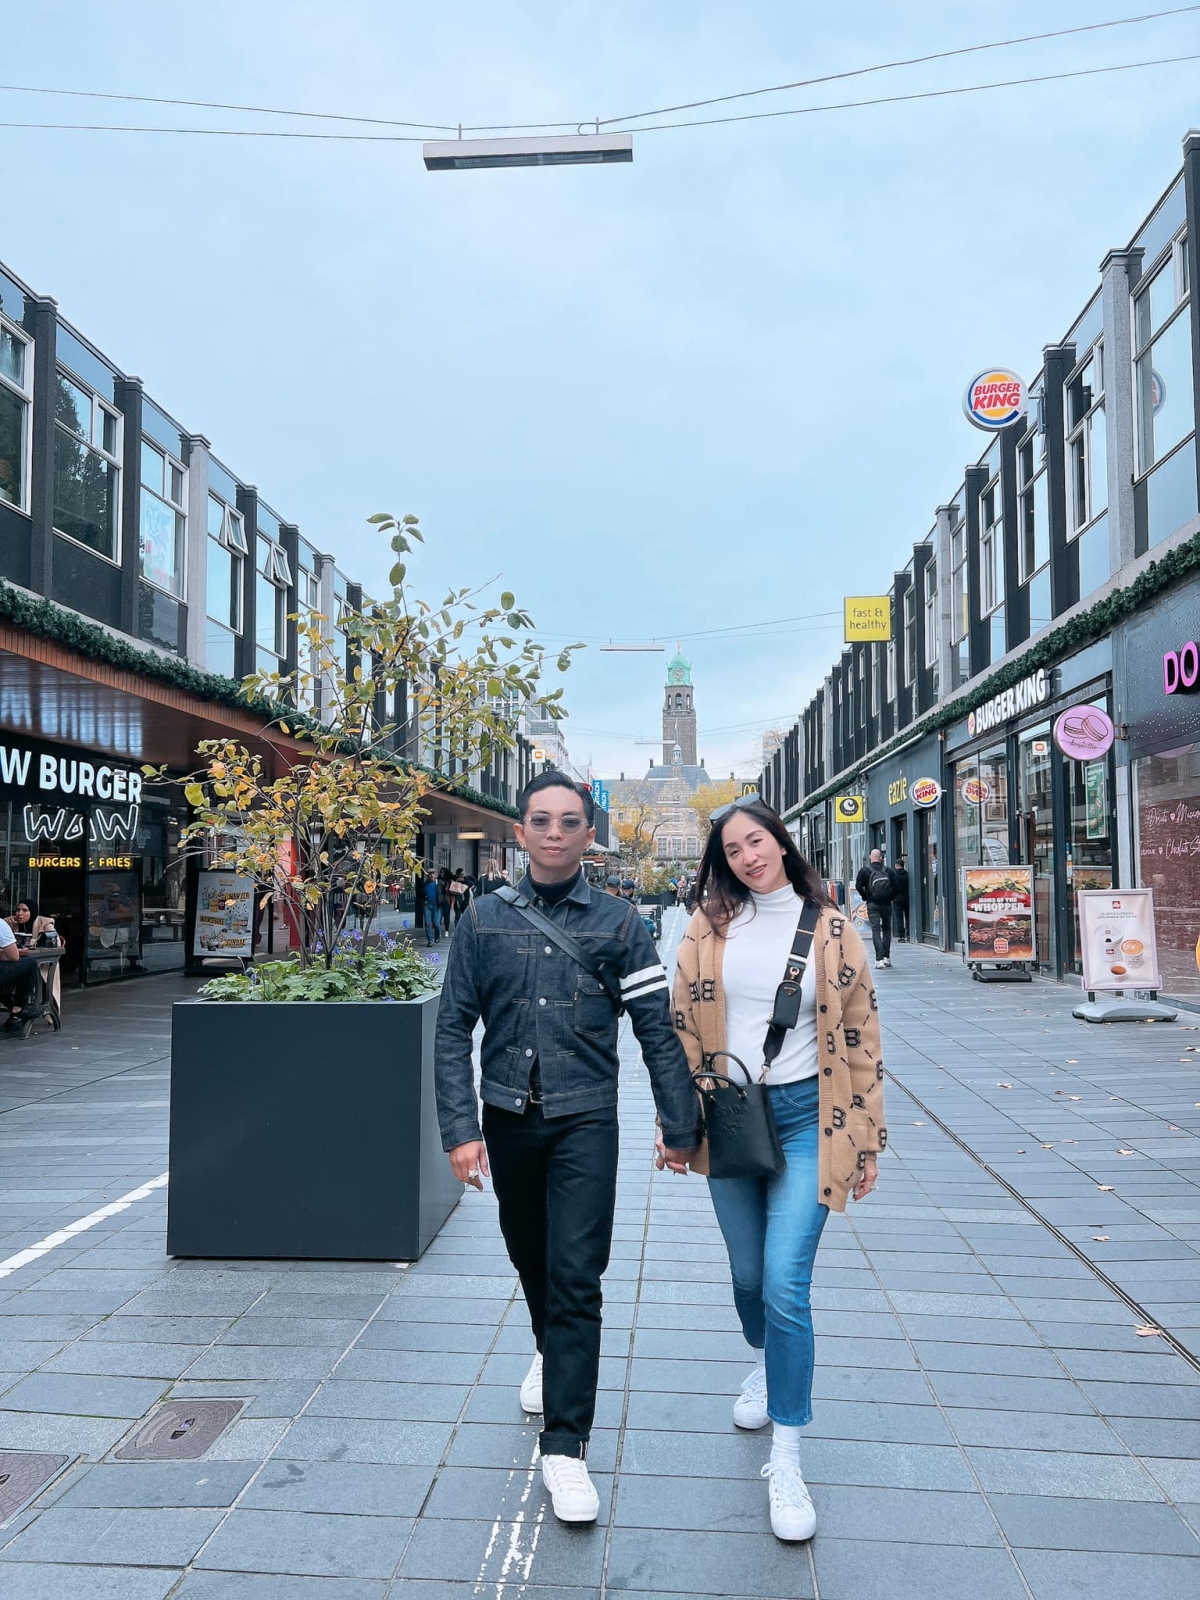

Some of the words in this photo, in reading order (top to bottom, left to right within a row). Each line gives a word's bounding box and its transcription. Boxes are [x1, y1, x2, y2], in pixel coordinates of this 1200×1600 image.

[974, 383, 1021, 396] BURGER
[973, 393, 1021, 411] KING
[853, 608, 871, 618] fast
[875, 607, 883, 617] &
[849, 620, 887, 631] healthy
[1163, 641, 1199, 695] DO
[976, 687, 1015, 735] BURGER
[1016, 668, 1047, 714] KING
[39, 753, 142, 803] BURGER
[888, 769, 908, 806] eazie
[914, 783, 936, 795] BURGER
[916, 788, 937, 801] KING
[29, 857, 81, 868] BURGERS
[99, 857, 132, 868] FRIES
[971, 902, 1025, 912] WHOPPER
